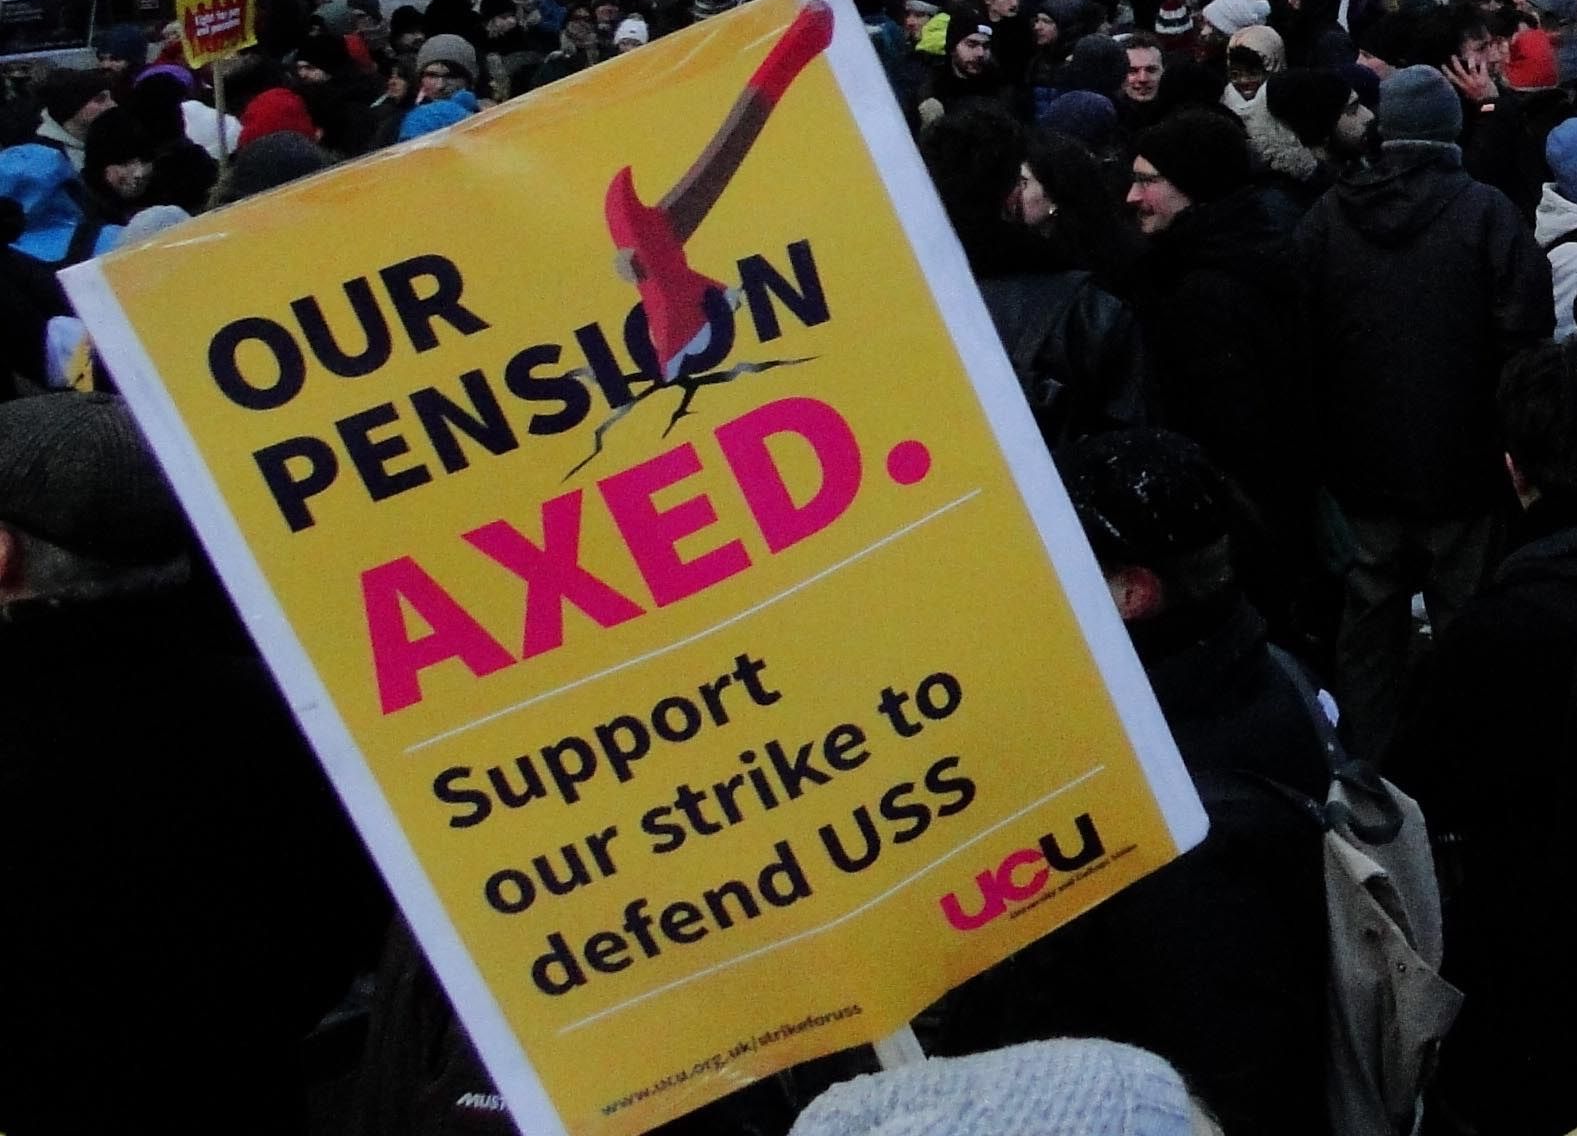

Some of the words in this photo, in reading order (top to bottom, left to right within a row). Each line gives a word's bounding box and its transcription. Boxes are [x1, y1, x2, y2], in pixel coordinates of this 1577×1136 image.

[207, 250, 492, 410] OUR
[252, 238, 830, 533] PENSION
[359, 395, 933, 716] AXED.
[431, 653, 783, 831] Support
[482, 824, 622, 917] our
[638, 722, 873, 860] strike
[877, 668, 966, 743] to
[529, 849, 816, 1000] defend
[822, 754, 980, 875] USS
